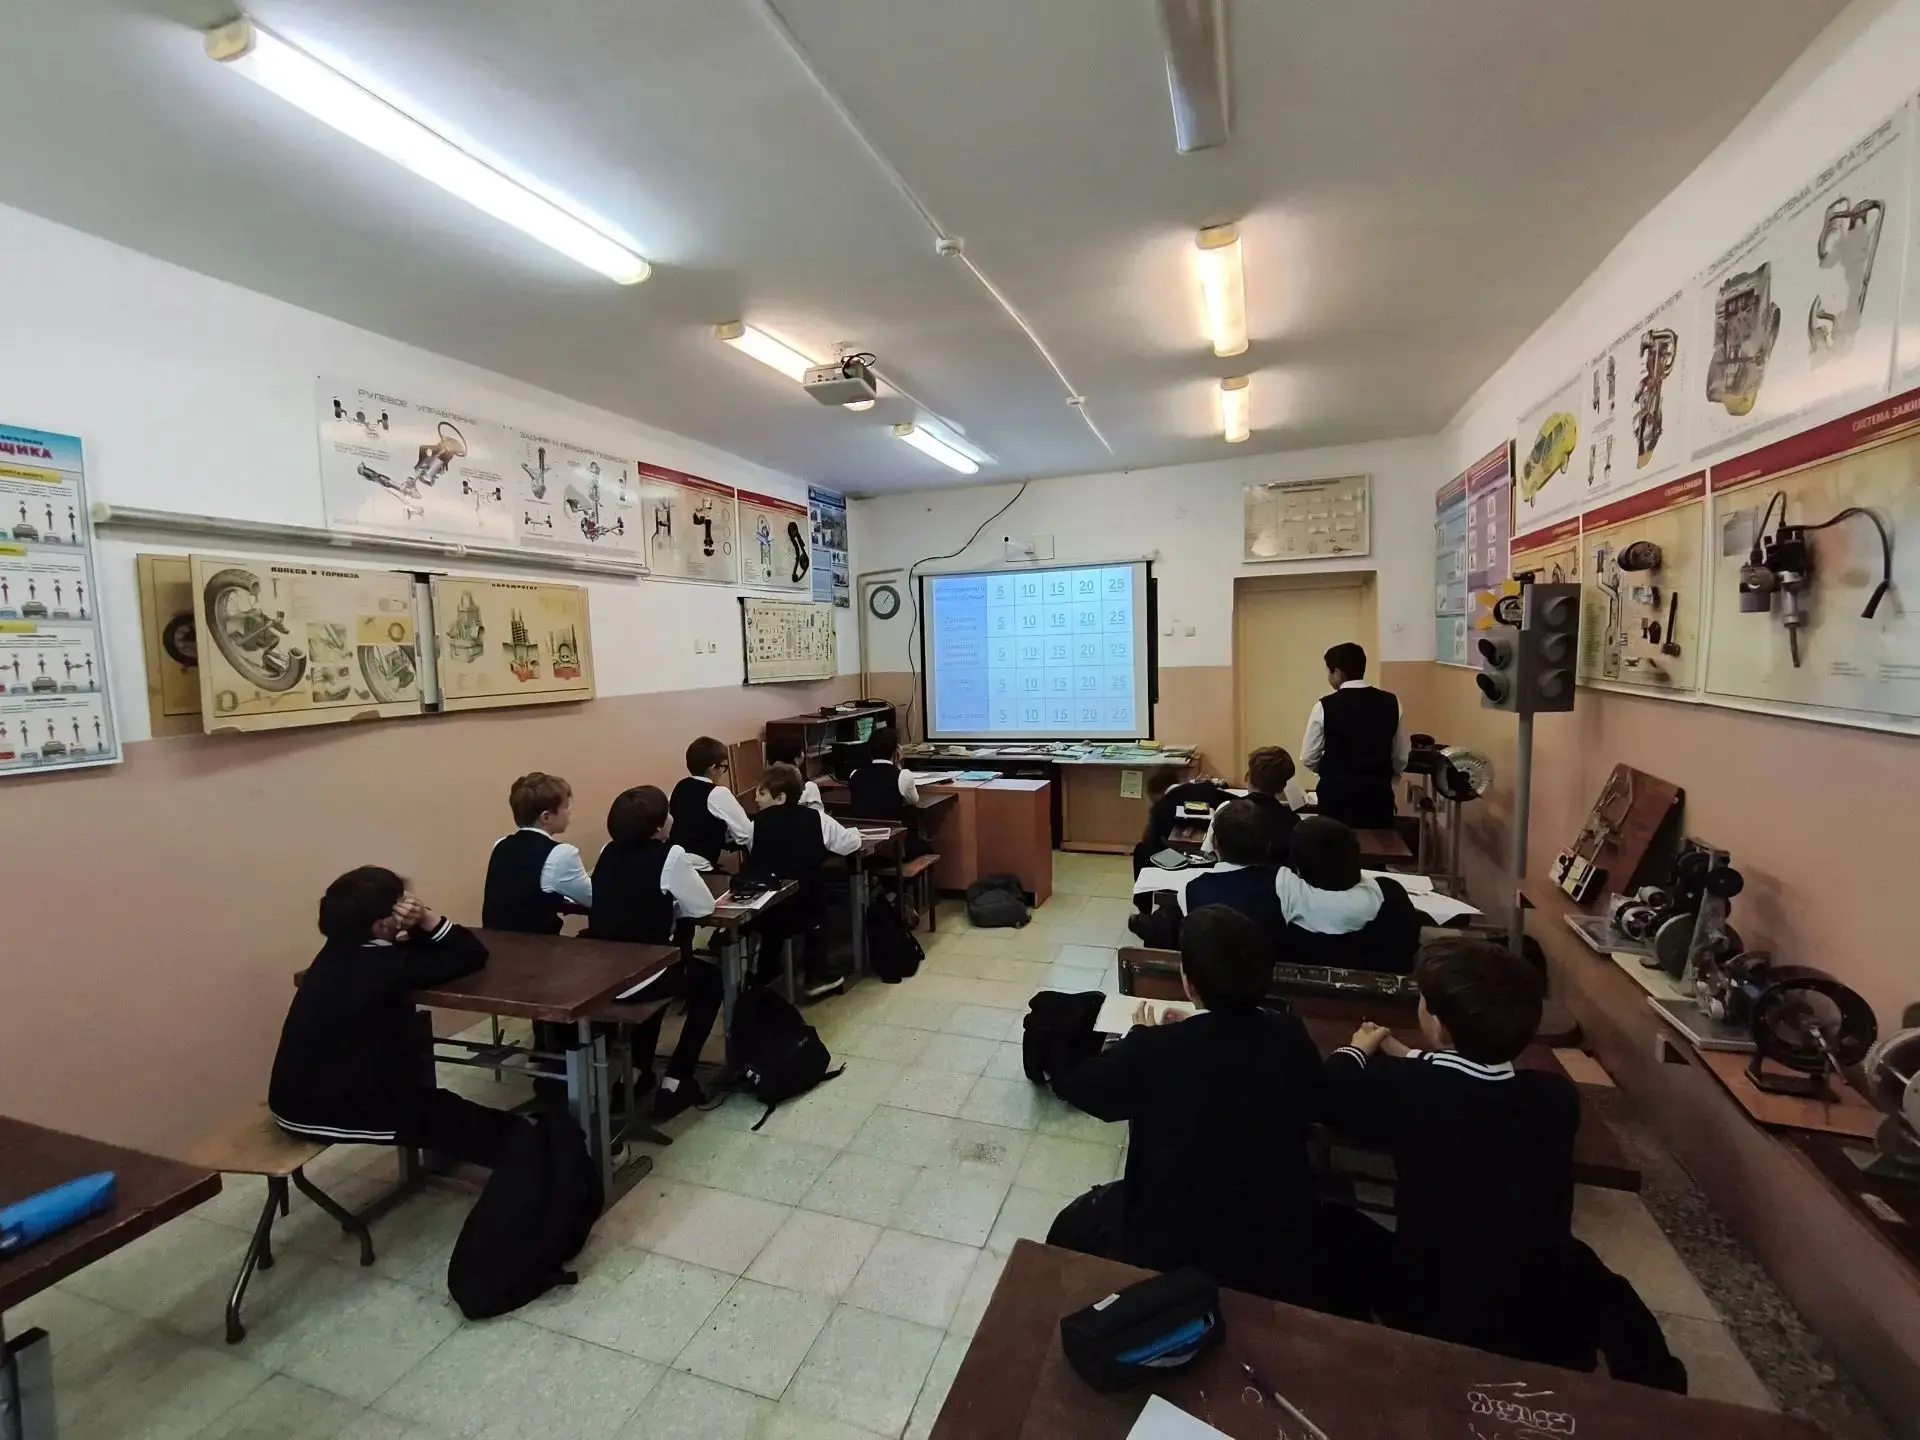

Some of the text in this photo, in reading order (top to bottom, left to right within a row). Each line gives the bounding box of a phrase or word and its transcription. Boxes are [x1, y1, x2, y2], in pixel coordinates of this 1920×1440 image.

[357, 388, 409, 408] РУЛЕВОЕ
[1852, 409, 1890, 432] СИСТЕМА
[271, 566, 307, 575] КОЛЕСА
[320, 570, 360, 579] ТОРМОЗА
[1021, 584, 1036, 595] 10
[1050, 582, 1065, 593] 15
[1079, 580, 1094, 591] 20
[1108, 578, 1124, 590] 25
[1022, 614, 1036, 626] 10
[1050, 613, 1066, 624] 15
[1080, 612, 1095, 623] 20
[1110, 610, 1125, 622] 25
[1024, 647, 1038, 657] 10
[1052, 646, 1066, 656] 15
[1080, 644, 1096, 656] 20
[1111, 643, 1126, 655] 25
[1024, 678, 1038, 689] 10
[1052, 677, 1067, 688] 15
[1081, 676, 1096, 688] 20
[1111, 675, 1127, 688] 25
[1024, 709, 1039, 720] 10
[1053, 709, 1068, 720] 15
[1082, 708, 1097, 720] 20
[1111, 708, 1128, 720] 25
